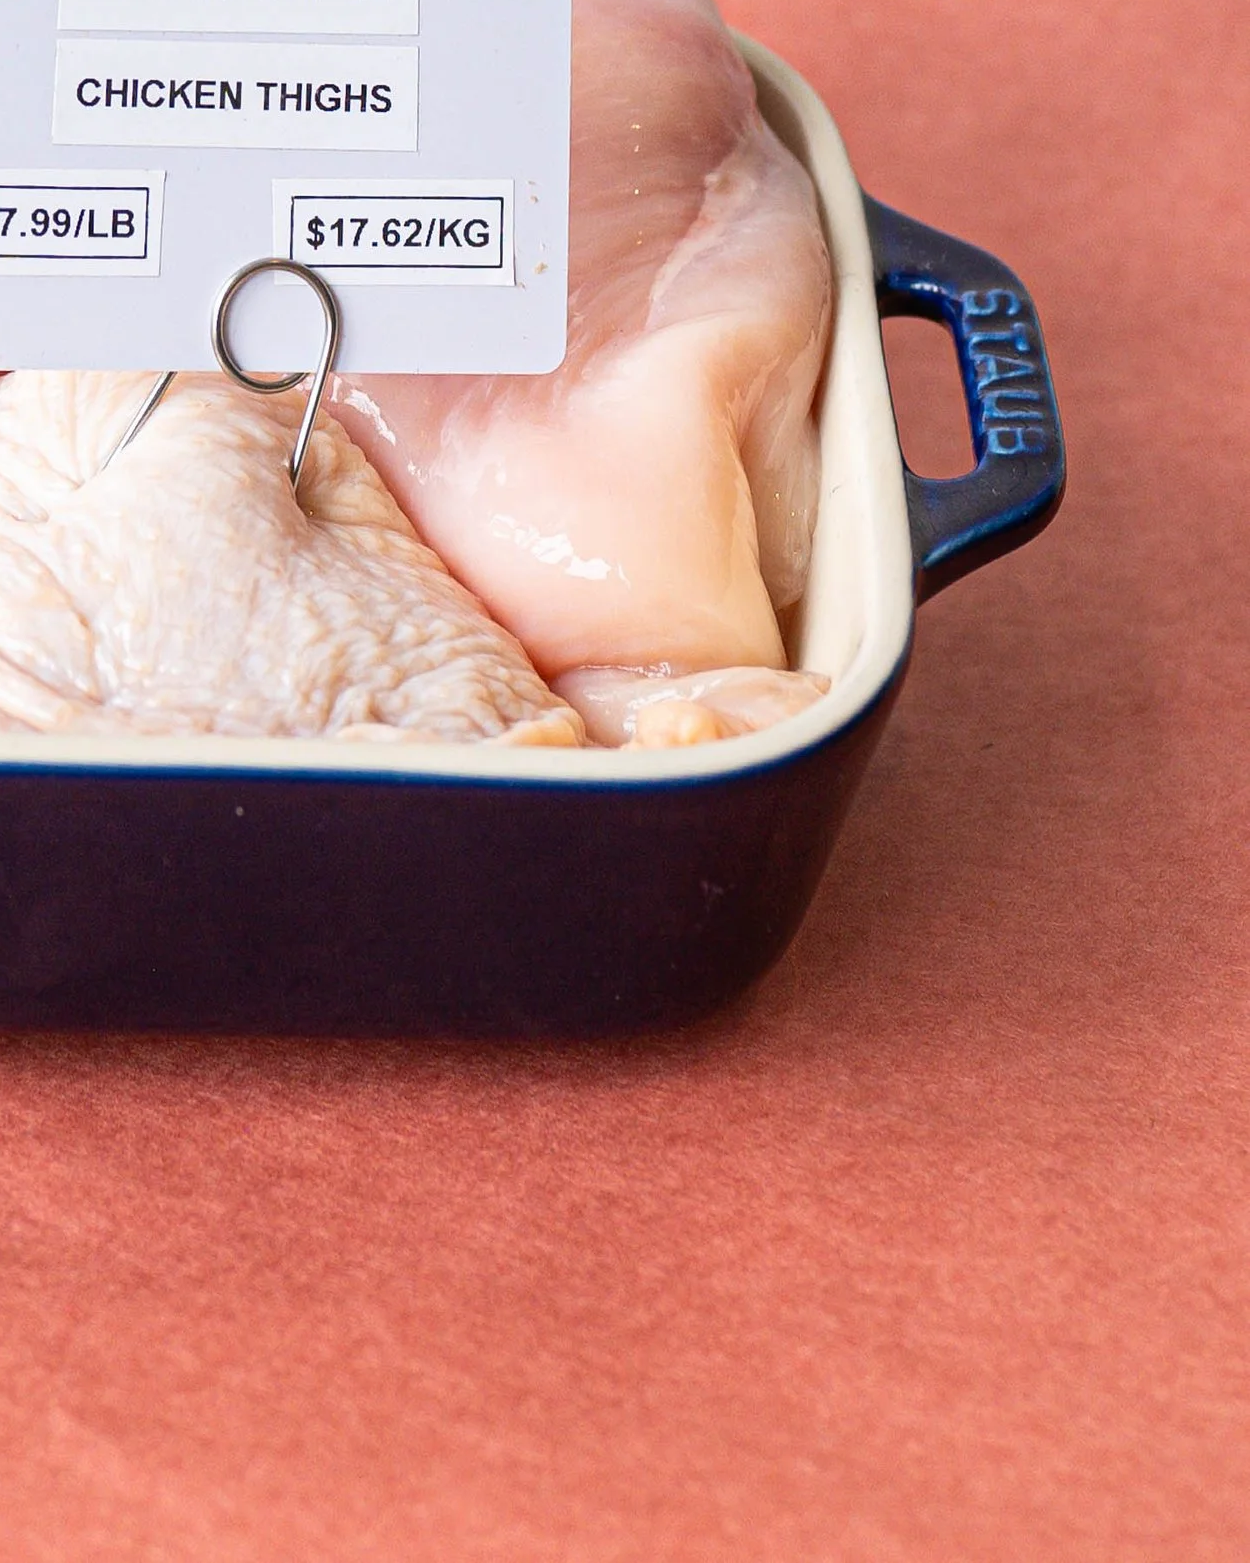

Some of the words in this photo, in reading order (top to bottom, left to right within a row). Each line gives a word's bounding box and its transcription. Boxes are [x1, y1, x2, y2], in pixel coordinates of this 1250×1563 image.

[76, 77, 243, 110] CHICKEN
[256, 81, 392, 113] THIGHS
[305, 215, 490, 251] $17.62/KG
[962, 289, 1046, 454] STAUB
